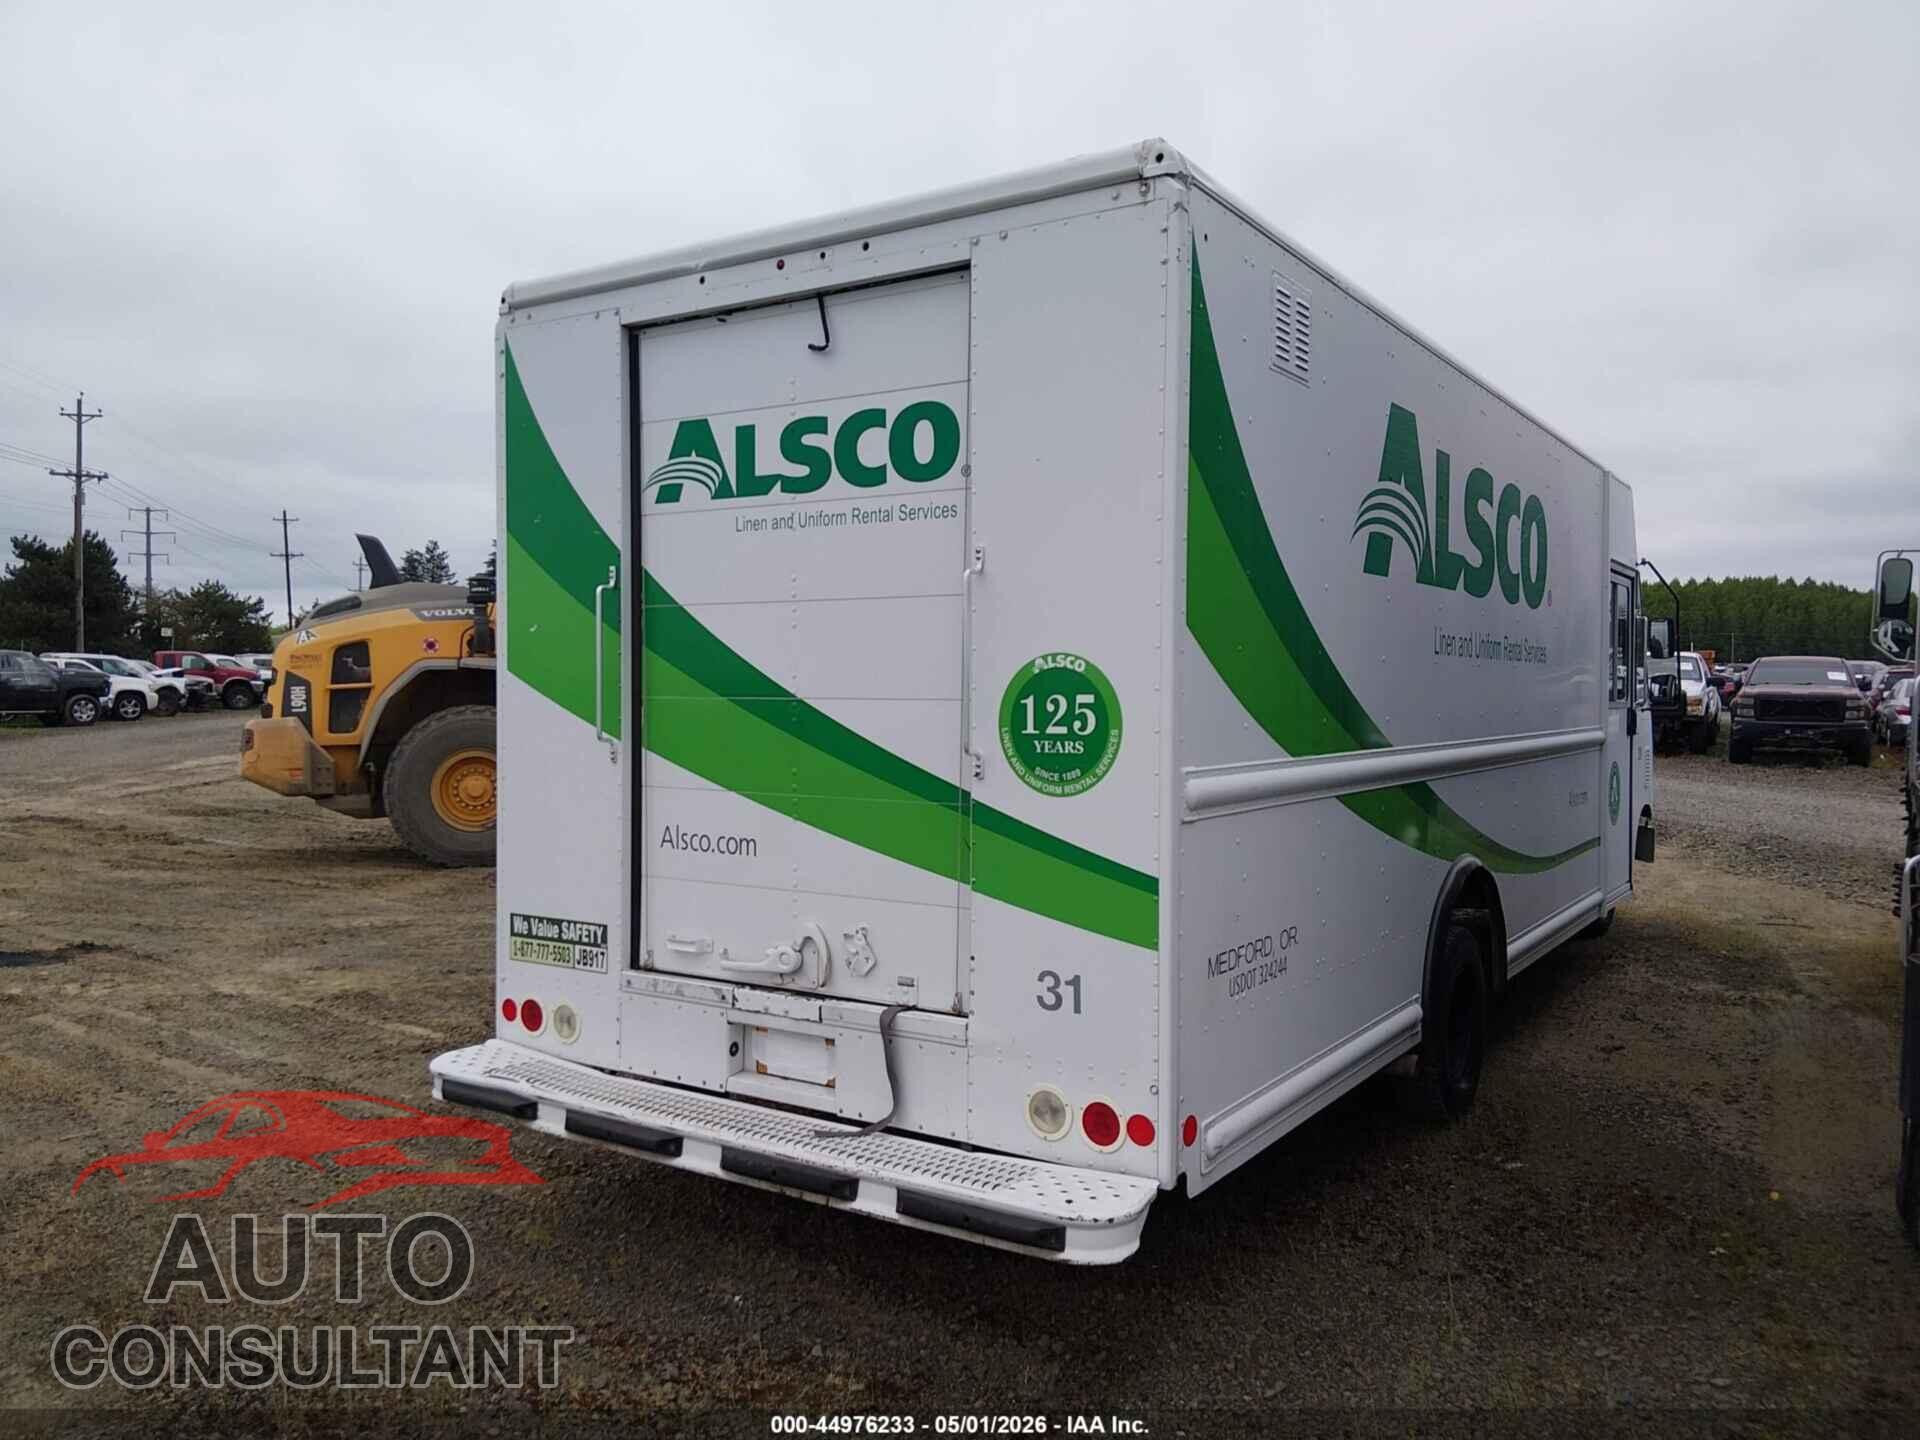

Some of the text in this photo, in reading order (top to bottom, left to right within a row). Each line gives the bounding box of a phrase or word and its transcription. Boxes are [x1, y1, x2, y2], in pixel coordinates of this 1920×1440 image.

[643, 401, 960, 504] ALSCO
[735, 502, 958, 533] Linen and Uniform Rental Services
[1351, 402, 1548, 610] ALSCO
[1434, 626, 1456, 656] Linen
[1458, 632, 1473, 658] and
[1033, 654, 1086, 674] ALSCO
[1020, 694, 1097, 736] 125
[1033, 740, 1085, 754] YEARS
[1034, 766, 1060, 782] SINCE
[660, 824, 757, 857] Alsco.com
[513, 915, 604, 944] We Value SAFETY
[1280, 926, 1299, 950] OR
[1037, 970, 1081, 1014] 31
[1229, 967, 1257, 998] USDOT
